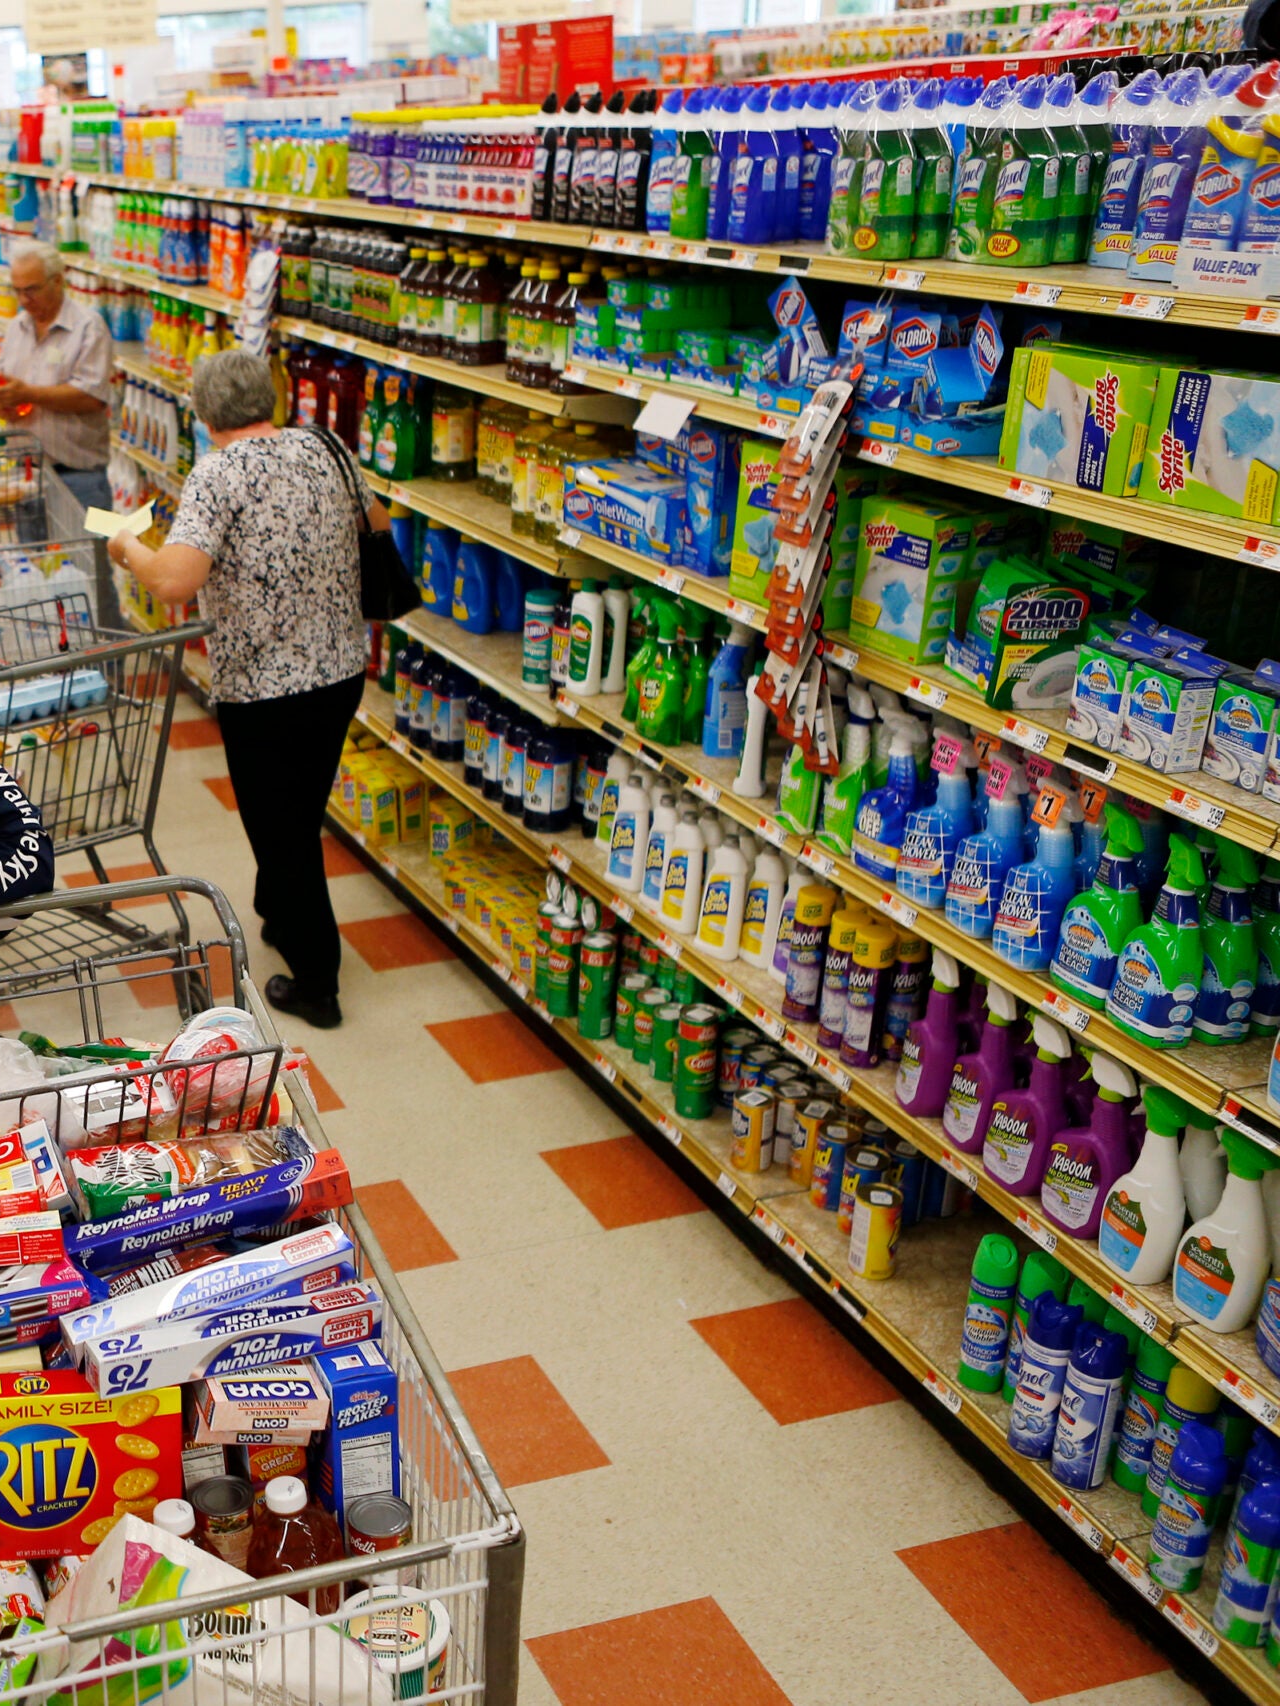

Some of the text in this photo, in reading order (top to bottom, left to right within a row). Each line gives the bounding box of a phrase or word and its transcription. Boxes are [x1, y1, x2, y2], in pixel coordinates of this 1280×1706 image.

[1194, 174, 1233, 196] CLOROX
[1140, 231, 1165, 241] POWER
[1192, 256, 1262, 277] VALUE PACK
[895, 328, 933, 348] CLOROX
[975, 330, 997, 366] CLOROX
[1173, 376, 1187, 414] Disposable
[1182, 377, 1195, 405] Toilet
[1186, 378, 1202, 422] Scrubber
[1083, 443, 1094, 484] Scrubber
[1088, 460, 1098, 484] Toilet
[1170, 438, 1186, 489] Brite
[591, 496, 644, 529] ToiletWand
[1010, 597, 1084, 620] 2000
[1007, 618, 1080, 631] FLUSHES
[1020, 629, 1059, 641] BLEACH
[938, 743, 954, 756] NEW
[991, 768, 1005, 781] NEW
[1041, 794, 1055, 816] #1
[906, 834, 934, 849] CLEAN
[902, 844, 938, 861] SHOWER
[956, 859, 982, 875] CLEAN
[951, 872, 984, 888] SHOWER
[1005, 890, 1031, 907] CLEAN
[999, 902, 1034, 920] SHOWER
[792, 931, 822, 945] ABOOM
[1059, 954, 1090, 977] BLEACH
[1060, 943, 1091, 968] FOAMING
[1112, 990, 1143, 1014] BLEACH
[1115, 979, 1145, 1005] FOAMING
[993, 1110, 1029, 1136] KABOOM
[1052, 1152, 1093, 1180] KABOOM
[220, 1174, 269, 1196] HEAVY
[226, 1186, 264, 1202] DUTY
[1070, 1177, 1094, 1190] Foam
[76, 1203, 161, 1239] Reynolds
[160, 1191, 211, 1215] Wrap
[121, 1209, 235, 1252] Reynolds Wrap
[1190, 1242, 1226, 1271] seventh
[181, 1264, 281, 1305] ALUMINUM
[189, 1264, 240, 1288] FOIL
[51, 1289, 83, 1302] Double
[51, 1298, 70, 1310] Stuf
[72, 1306, 116, 1341] 75
[210, 1308, 310, 1336] ALUMINUM
[217, 1309, 270, 1327] FOIL
[328, 1320, 365, 1335] BASKET
[229, 1333, 281, 1357] FOIL
[325, 1327, 367, 1343] MARKET
[98, 1334, 143, 1358] 75
[212, 1340, 316, 1374] ALUMINUM
[14, 1376, 50, 1393] RITZ
[106, 1358, 153, 1396] 75
[1019, 1368, 1051, 1389] ysol
[228, 1381, 312, 1398] GOYA
[59, 1399, 114, 1416] SIZE!
[264, 1409, 300, 1417] MEXICAN
[337, 1395, 388, 1421] FROSTED
[1023, 1400, 1043, 1413] FOAM
[254, 1418, 288, 1428] GOYA
[338, 1407, 382, 1428] FLAKES
[238, 1433, 271, 1442] GOYA
[260, 1453, 294, 1472] GREAT
[36, 1499, 79, 1514] CRACKERS
